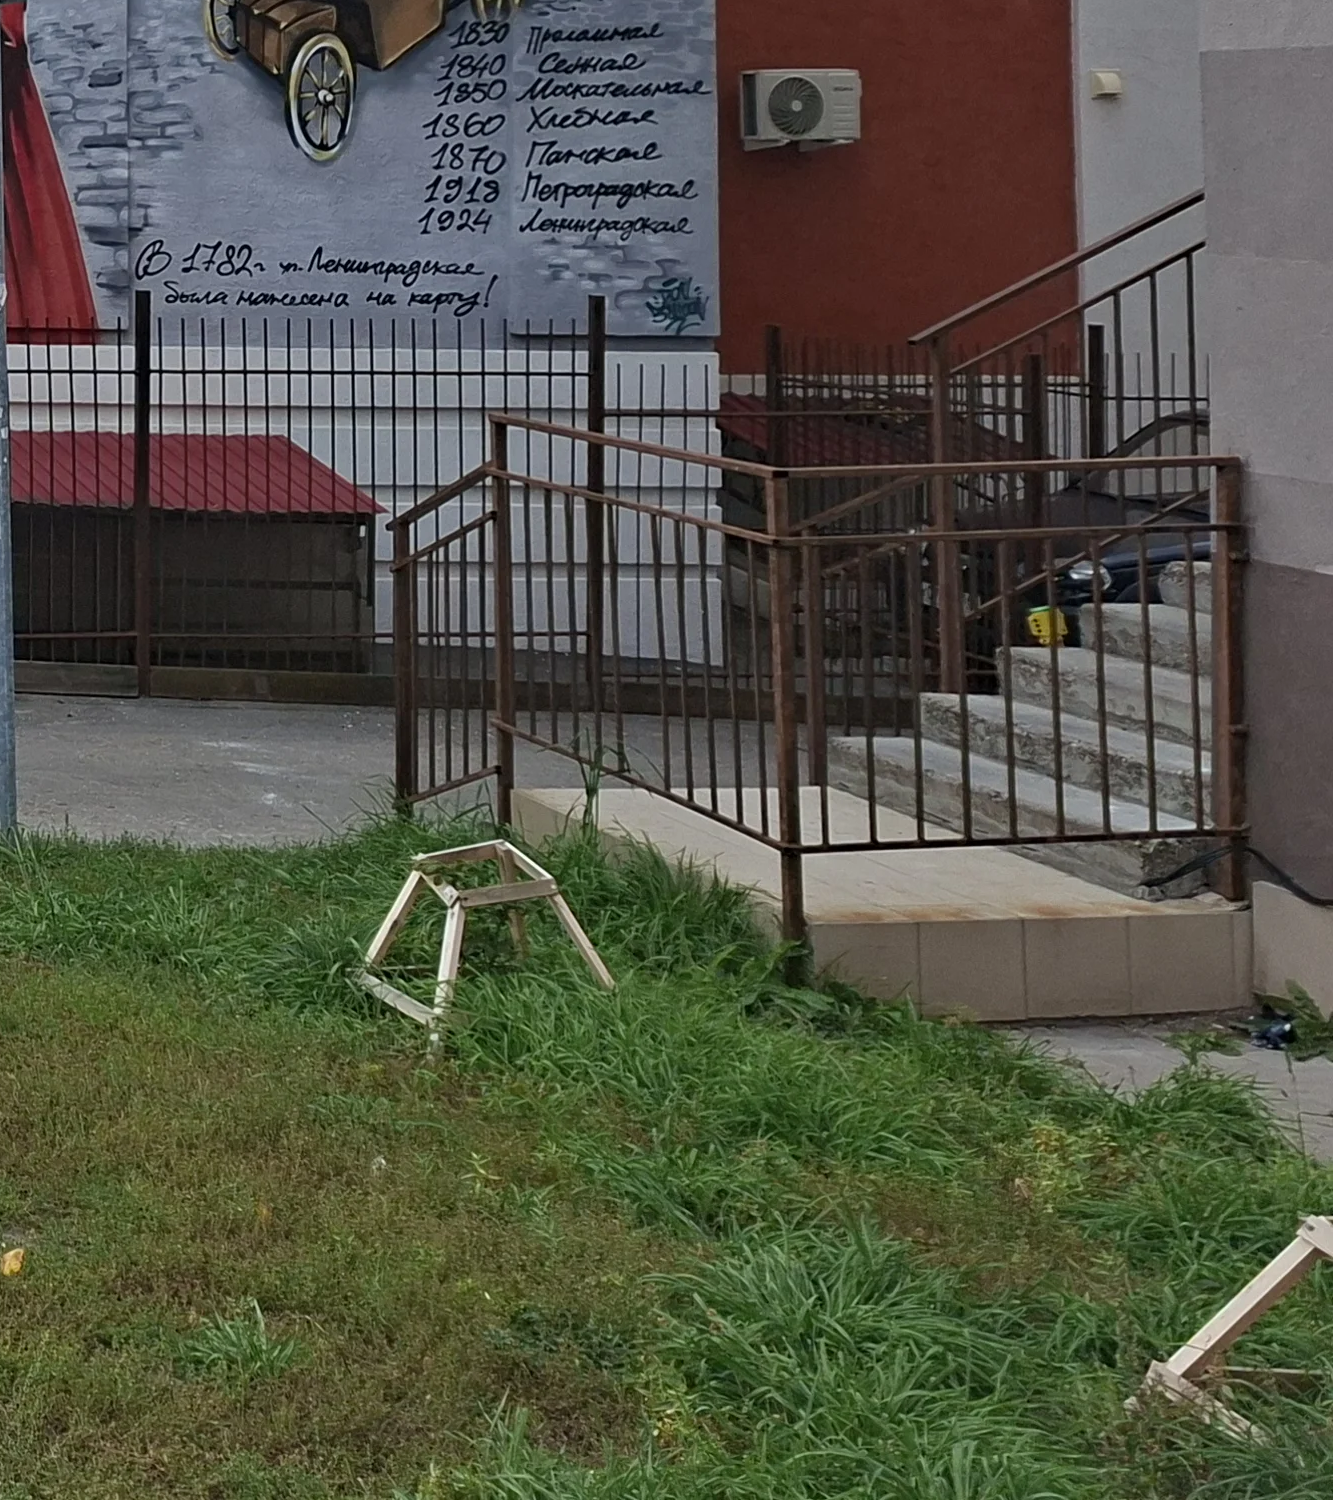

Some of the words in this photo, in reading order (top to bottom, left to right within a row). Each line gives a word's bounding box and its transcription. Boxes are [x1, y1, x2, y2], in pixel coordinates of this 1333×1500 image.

[448, 20, 510, 49] 1830
[437, 53, 506, 82] 1840
[434, 79, 507, 107] 1850
[516, 77, 713, 102] Москательная
[422, 112, 506, 140] 1860
[527, 106, 658, 133] Хлебная
[431, 142, 507, 175] 1870
[525, 140, 663, 168] Панская
[424, 175, 500, 205] 1918
[521, 170, 698, 210] Петроградская
[418, 207, 493, 235] 1924
[135, 239, 172, 280] В
[307, 246, 485, 288] Ленинградская
[164, 281, 228, 305] была
[366, 291, 397, 306] на
